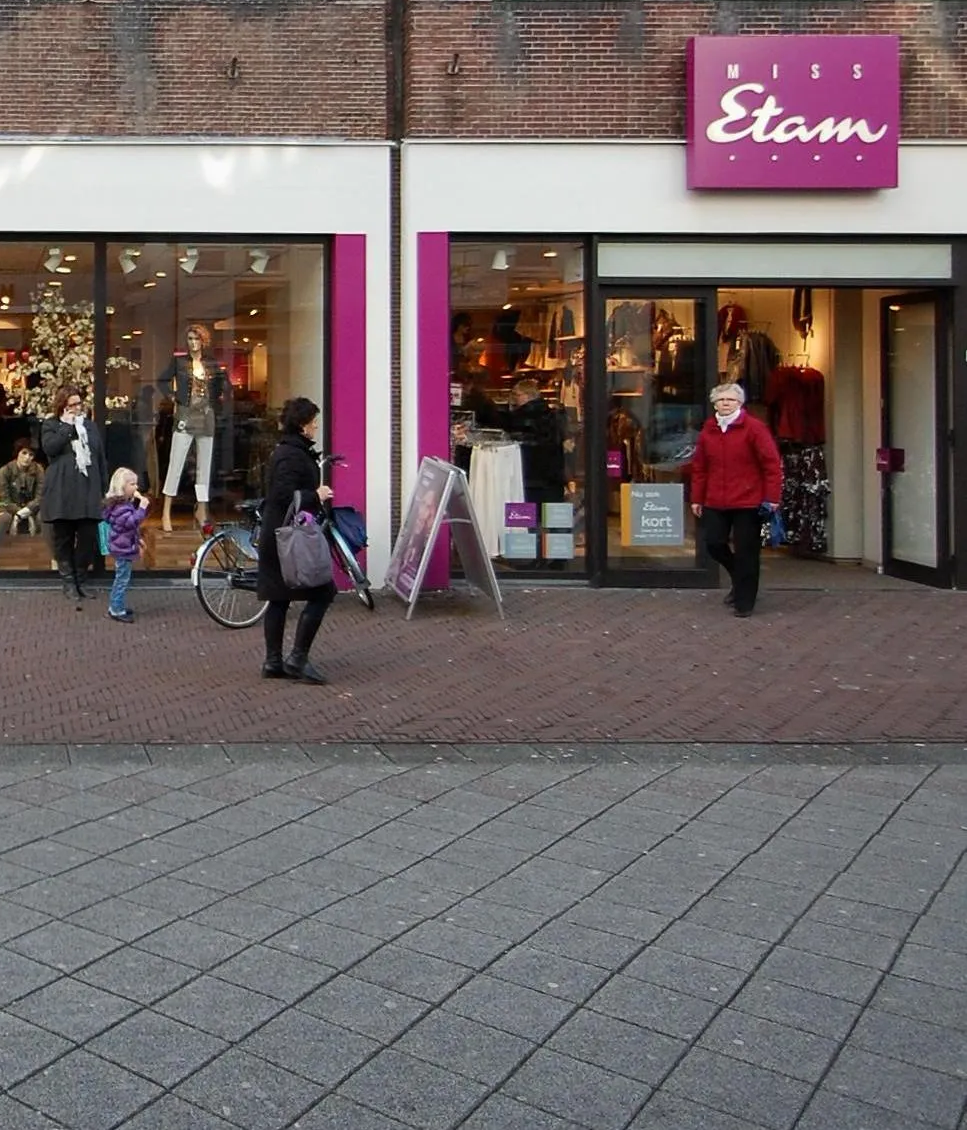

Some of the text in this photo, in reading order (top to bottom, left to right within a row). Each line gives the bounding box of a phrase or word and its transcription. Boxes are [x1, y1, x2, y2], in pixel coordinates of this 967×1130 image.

[727, 63, 862, 80] MISS
[705, 82, 889, 144] Etam
[641, 514, 673, 527] kort
